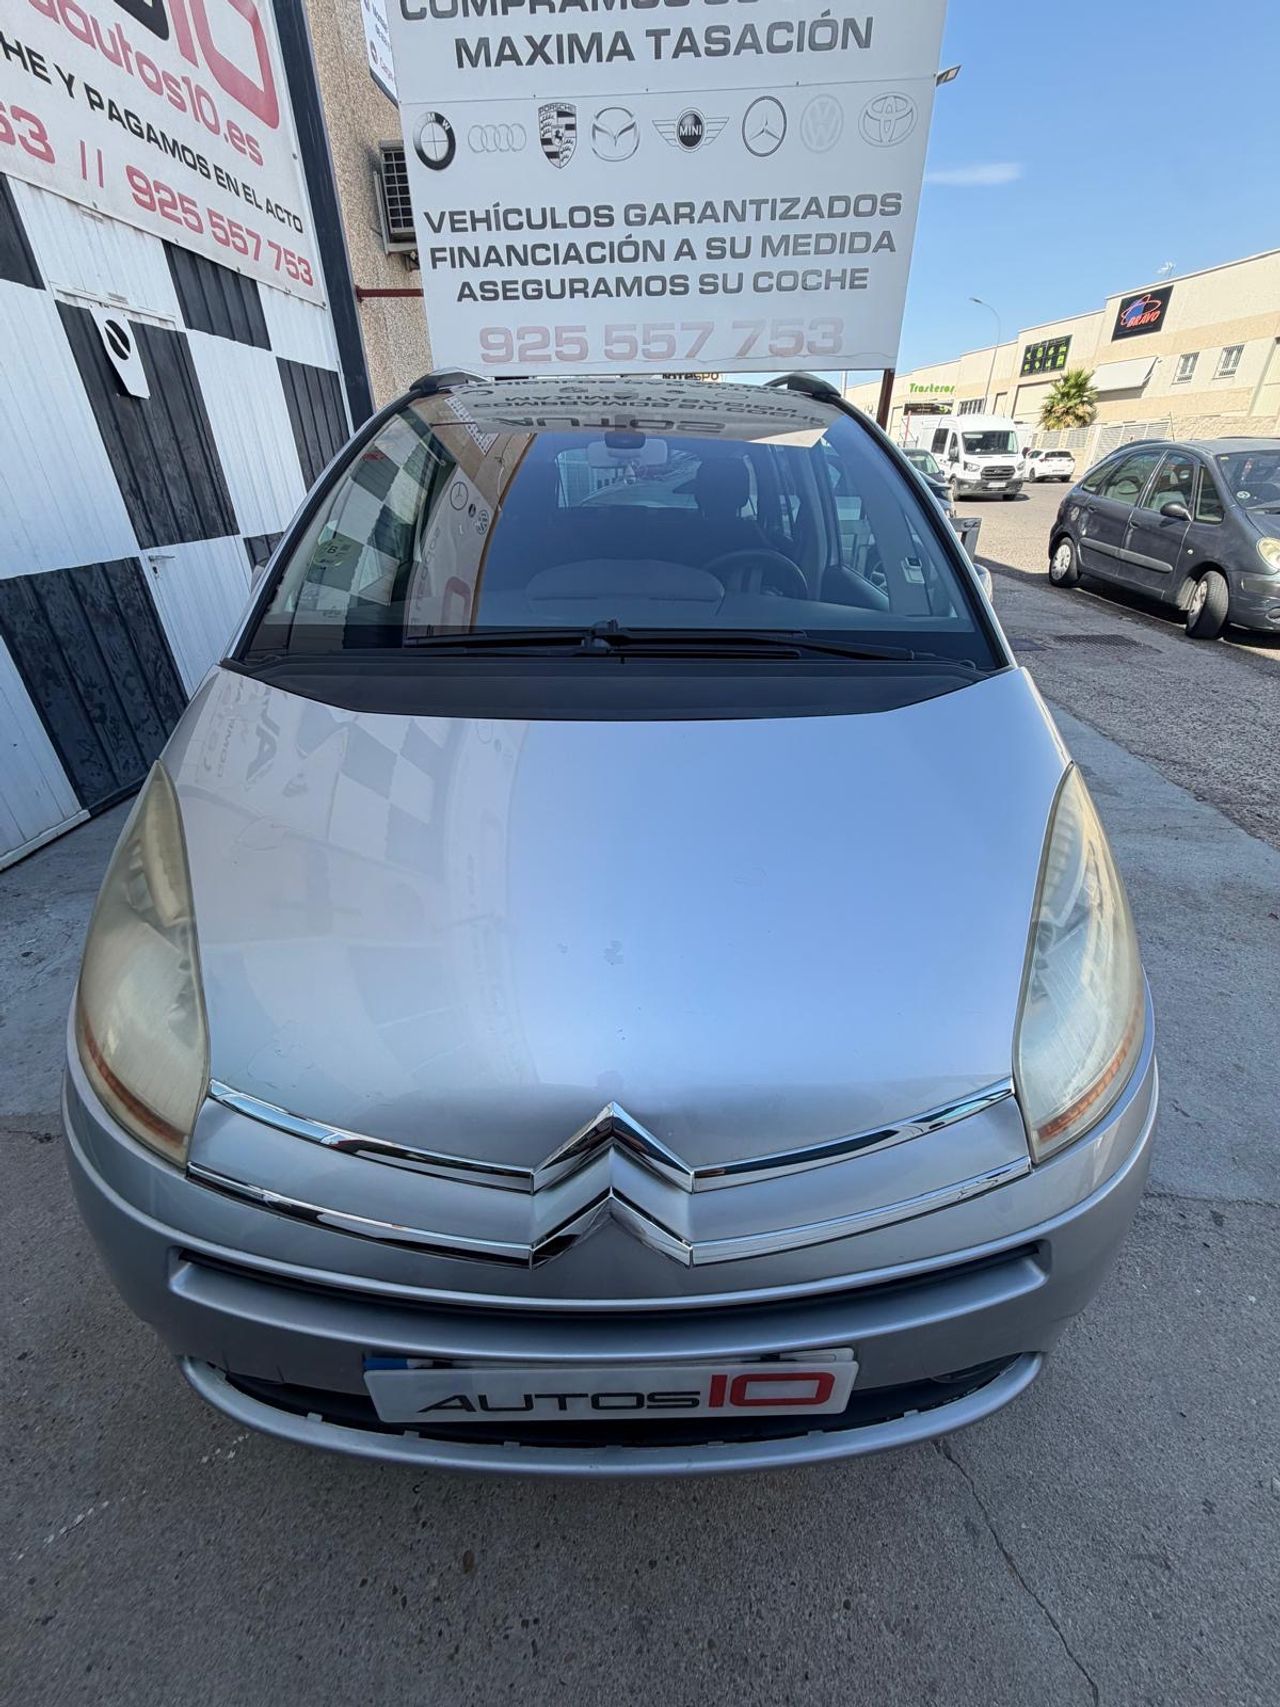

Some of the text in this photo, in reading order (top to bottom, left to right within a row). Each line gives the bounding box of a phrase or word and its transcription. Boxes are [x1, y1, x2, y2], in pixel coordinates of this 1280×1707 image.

[454, 9, 874, 69] MAXIMA TASACIÓN
[53, 63, 75, 99] Y
[84, 82, 211, 180] PAGAMOS
[213, 163, 240, 198] EN
[241, 182, 263, 211] EL
[265, 198, 304, 234] ACTO
[679, 125, 702, 136] MINI
[126, 164, 204, 235] 925
[206, 207, 262, 262] 557
[267, 239, 314, 287] 753
[423, 192, 903, 234] VEHÍCULOS GARANTIZADOS
[429, 230, 897, 270] FINANCIACIÓN A SU MEDIDA
[456, 267, 869, 302] ASEGURAMOS SU COCHE
[479, 317, 845, 363] 925 557 753
